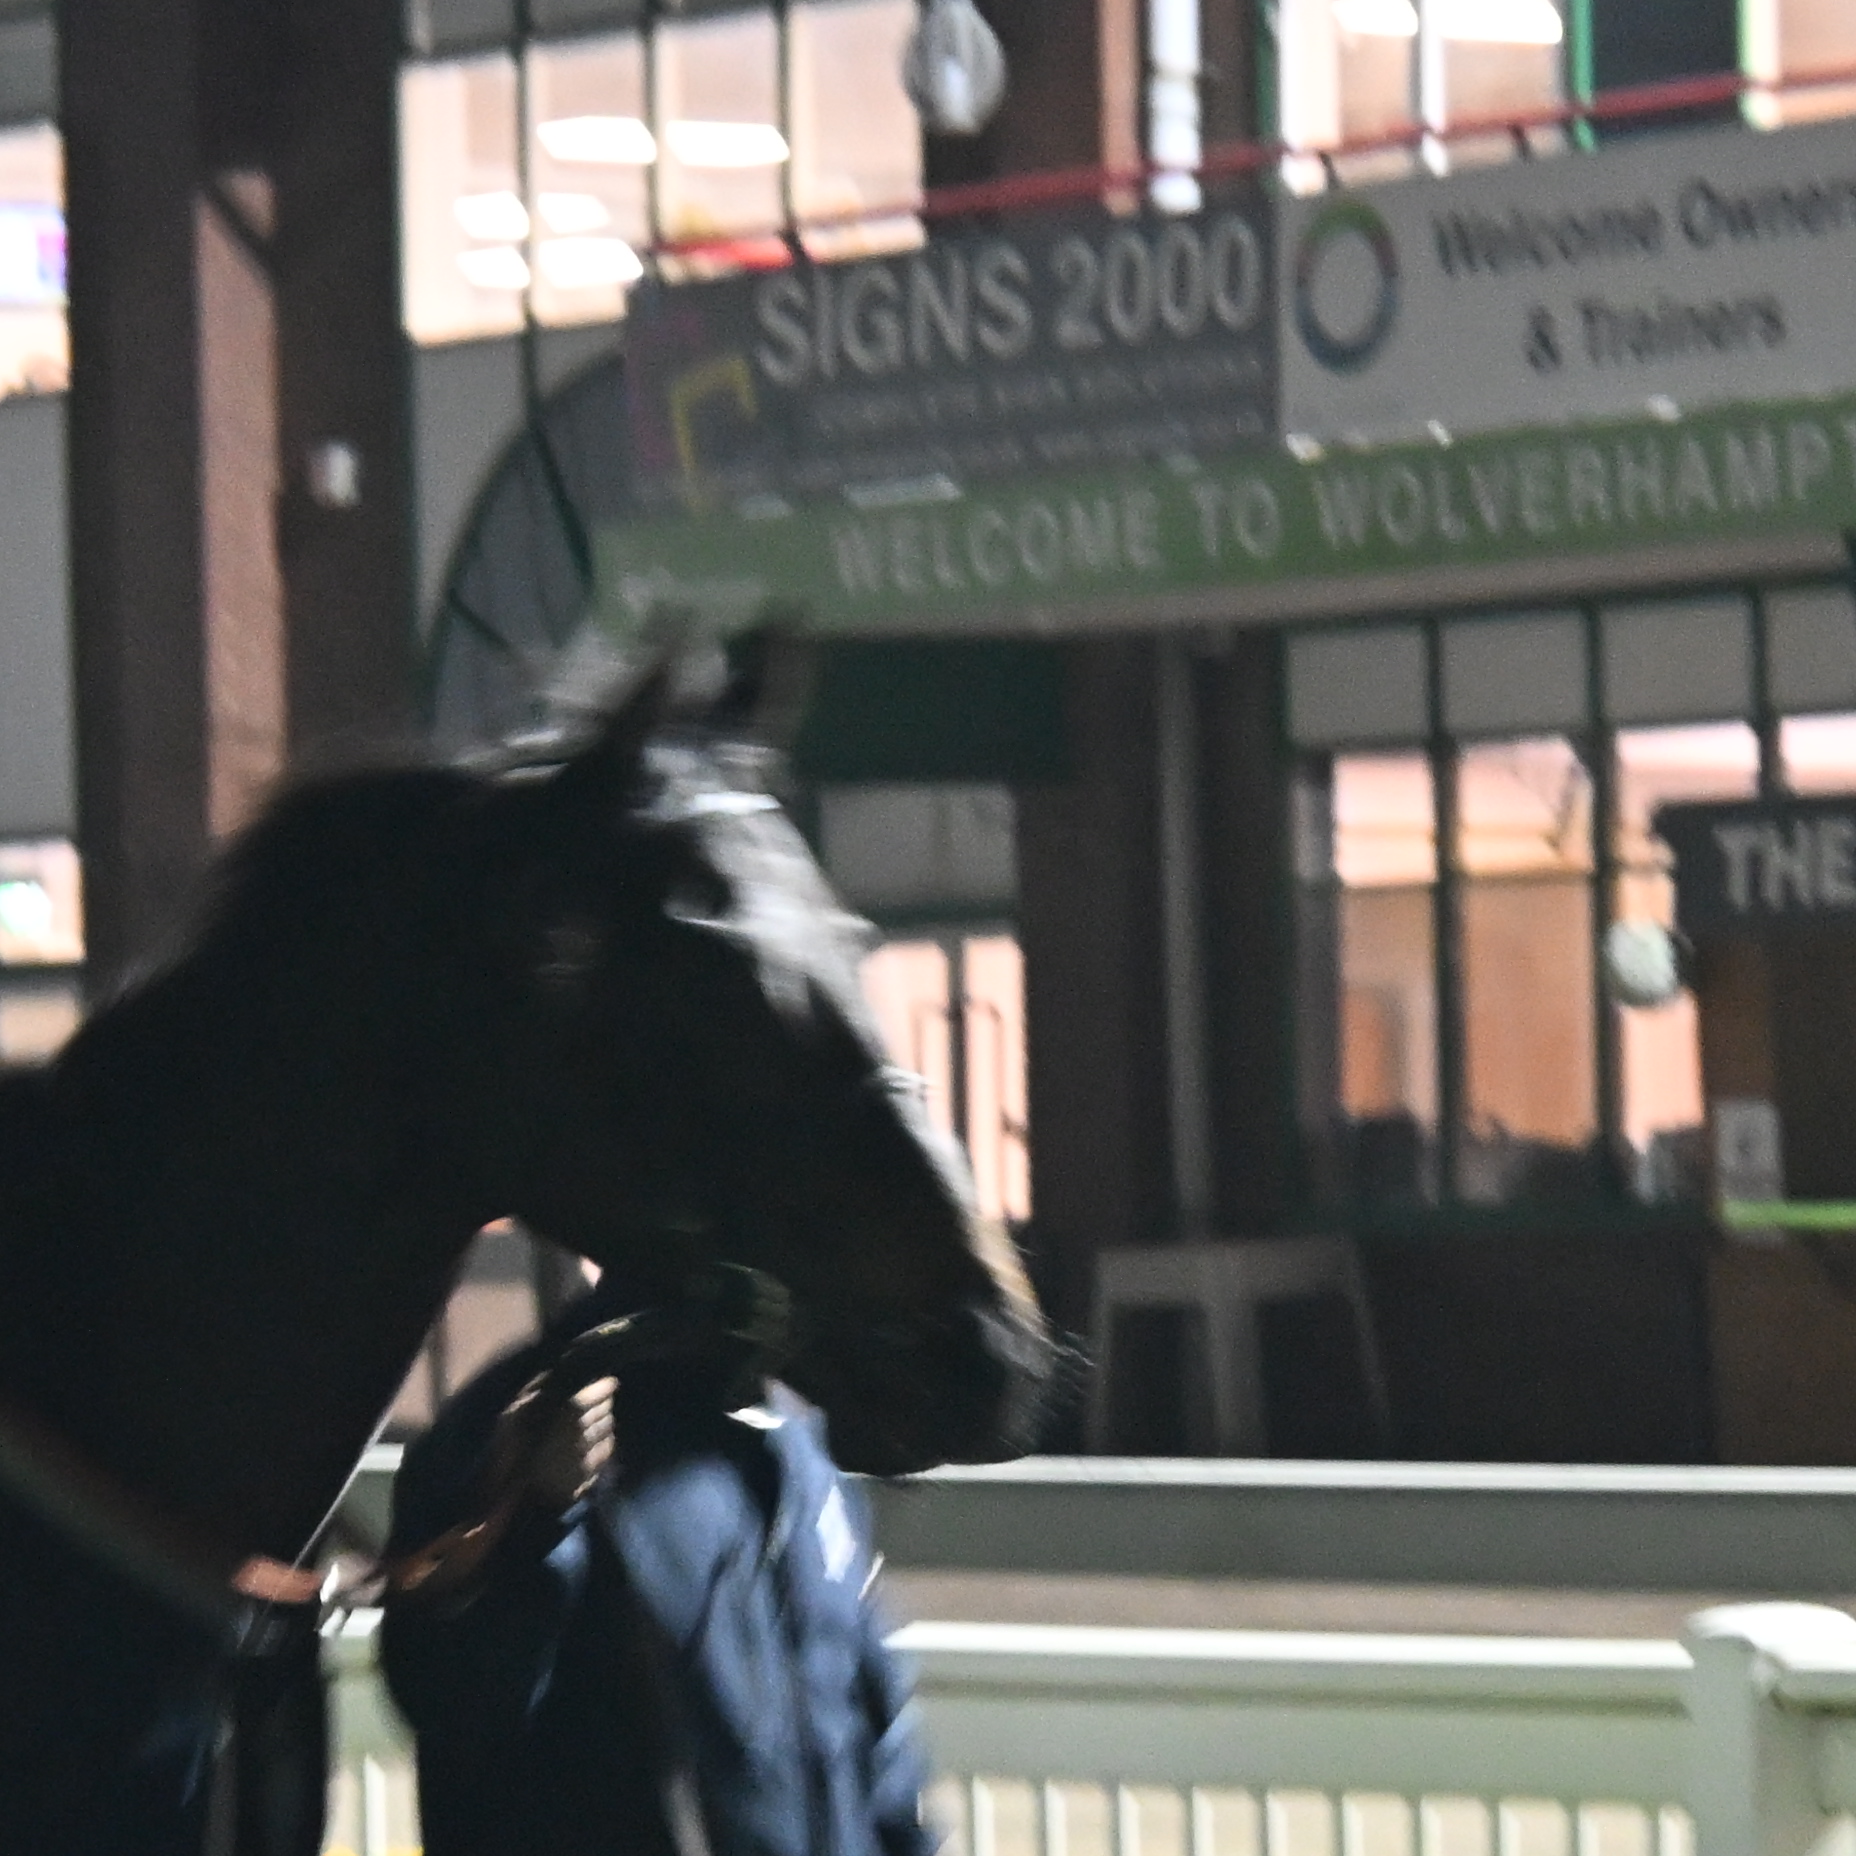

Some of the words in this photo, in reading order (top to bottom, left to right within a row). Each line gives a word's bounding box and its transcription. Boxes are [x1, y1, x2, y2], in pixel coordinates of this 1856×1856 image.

[1430, 197, 1662, 278] Welcome
[753, 240, 1033, 388] SIGNS
[1051, 214, 1265, 350] 2000
[1524, 306, 1558, 373] &
[1580, 292, 1787, 370] Trainers
[834, 473, 1165, 597] WELCOME
[1192, 465, 1284, 563] TO
